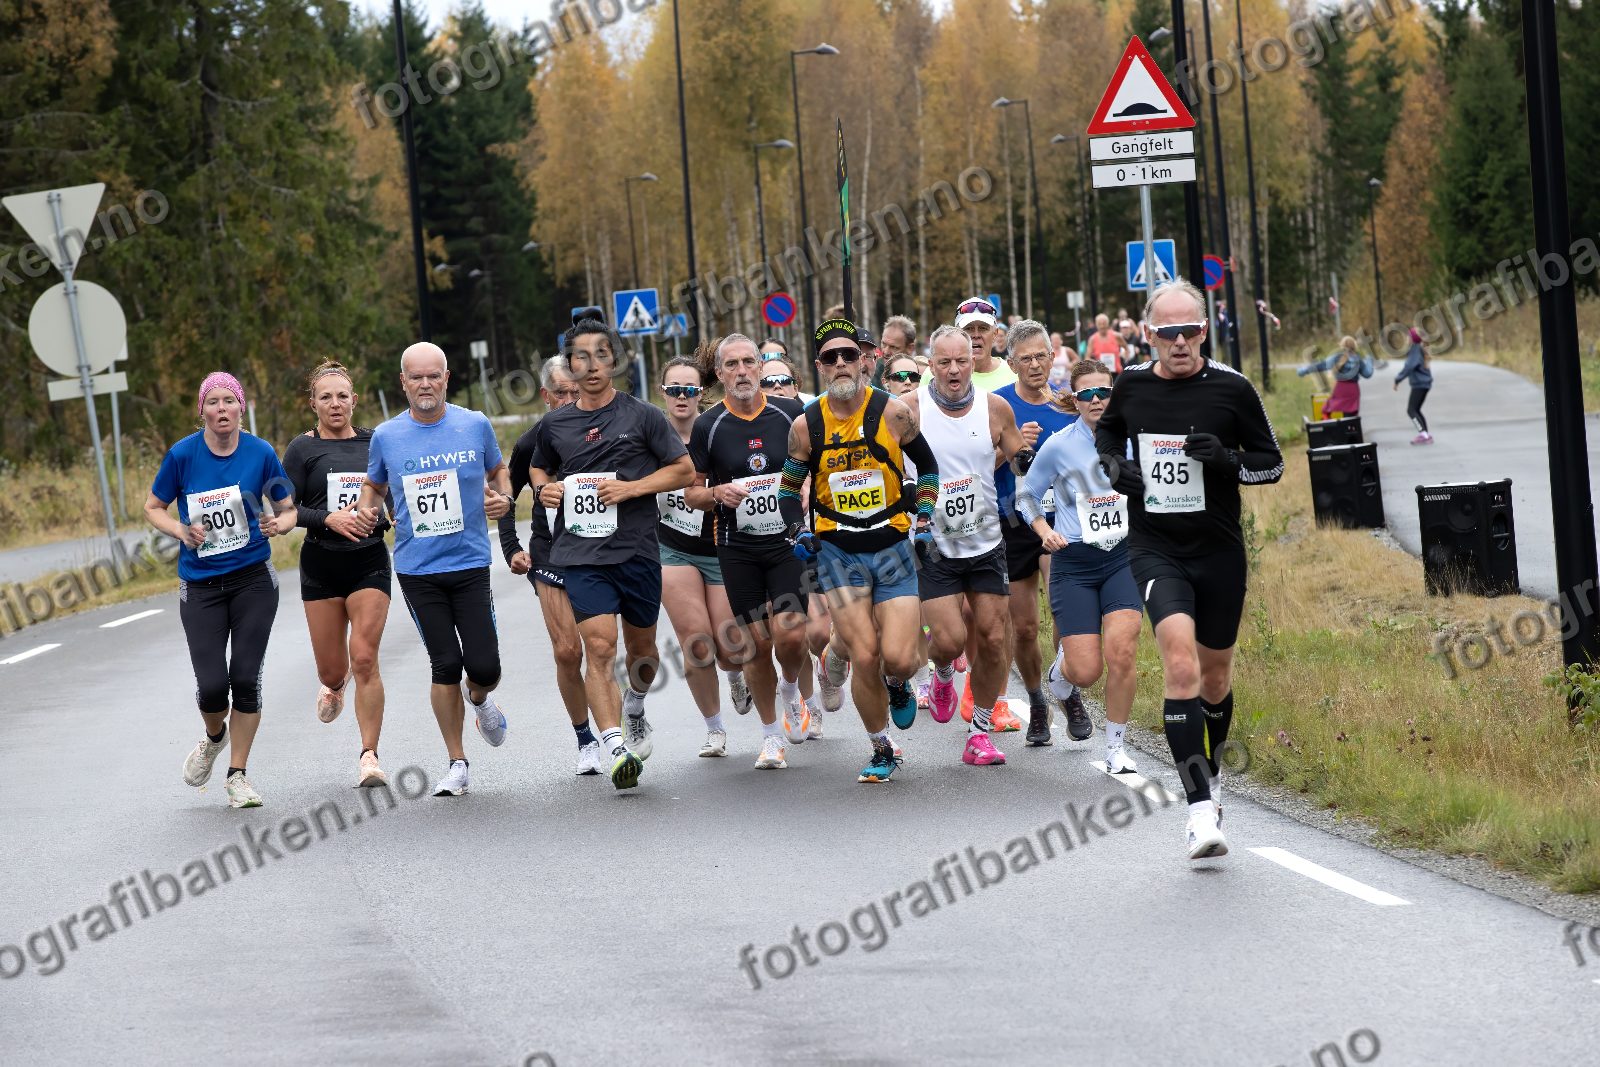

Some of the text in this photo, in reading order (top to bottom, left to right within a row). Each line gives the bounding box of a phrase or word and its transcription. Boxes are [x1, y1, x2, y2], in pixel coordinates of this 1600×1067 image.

[1111, 138, 1174, 155] Gangfelt
[1116, 168, 1126, 182] 0
[1141, 167, 1147, 180] 1
[1151, 166, 1172, 179] km
[419, 450, 477, 469] HYWER
[1155, 447, 1183, 456] LØPET
[415, 474, 448, 485] NORGES
[840, 471, 873, 482] NORGES
[1151, 461, 1190, 485] 435
[418, 480, 443, 491] LØPET
[745, 477, 776, 488] NORGES
[943, 477, 973, 490] NORGES
[946, 484, 970, 495] LØPET
[198, 491, 231, 504] NORGES
[337, 493, 358, 512] 54
[416, 491, 449, 515] 671
[574, 494, 607, 515] 838
[745, 494, 778, 516] 380
[837, 488, 882, 510] PACE
[945, 493, 975, 518] 697
[1088, 493, 1121, 504] NORGES
[1164, 494, 1202, 504] Aurskog
[201, 508, 236, 532] 600
[1089, 510, 1123, 532] 644
[1164, 713, 1187, 721] SELECT
